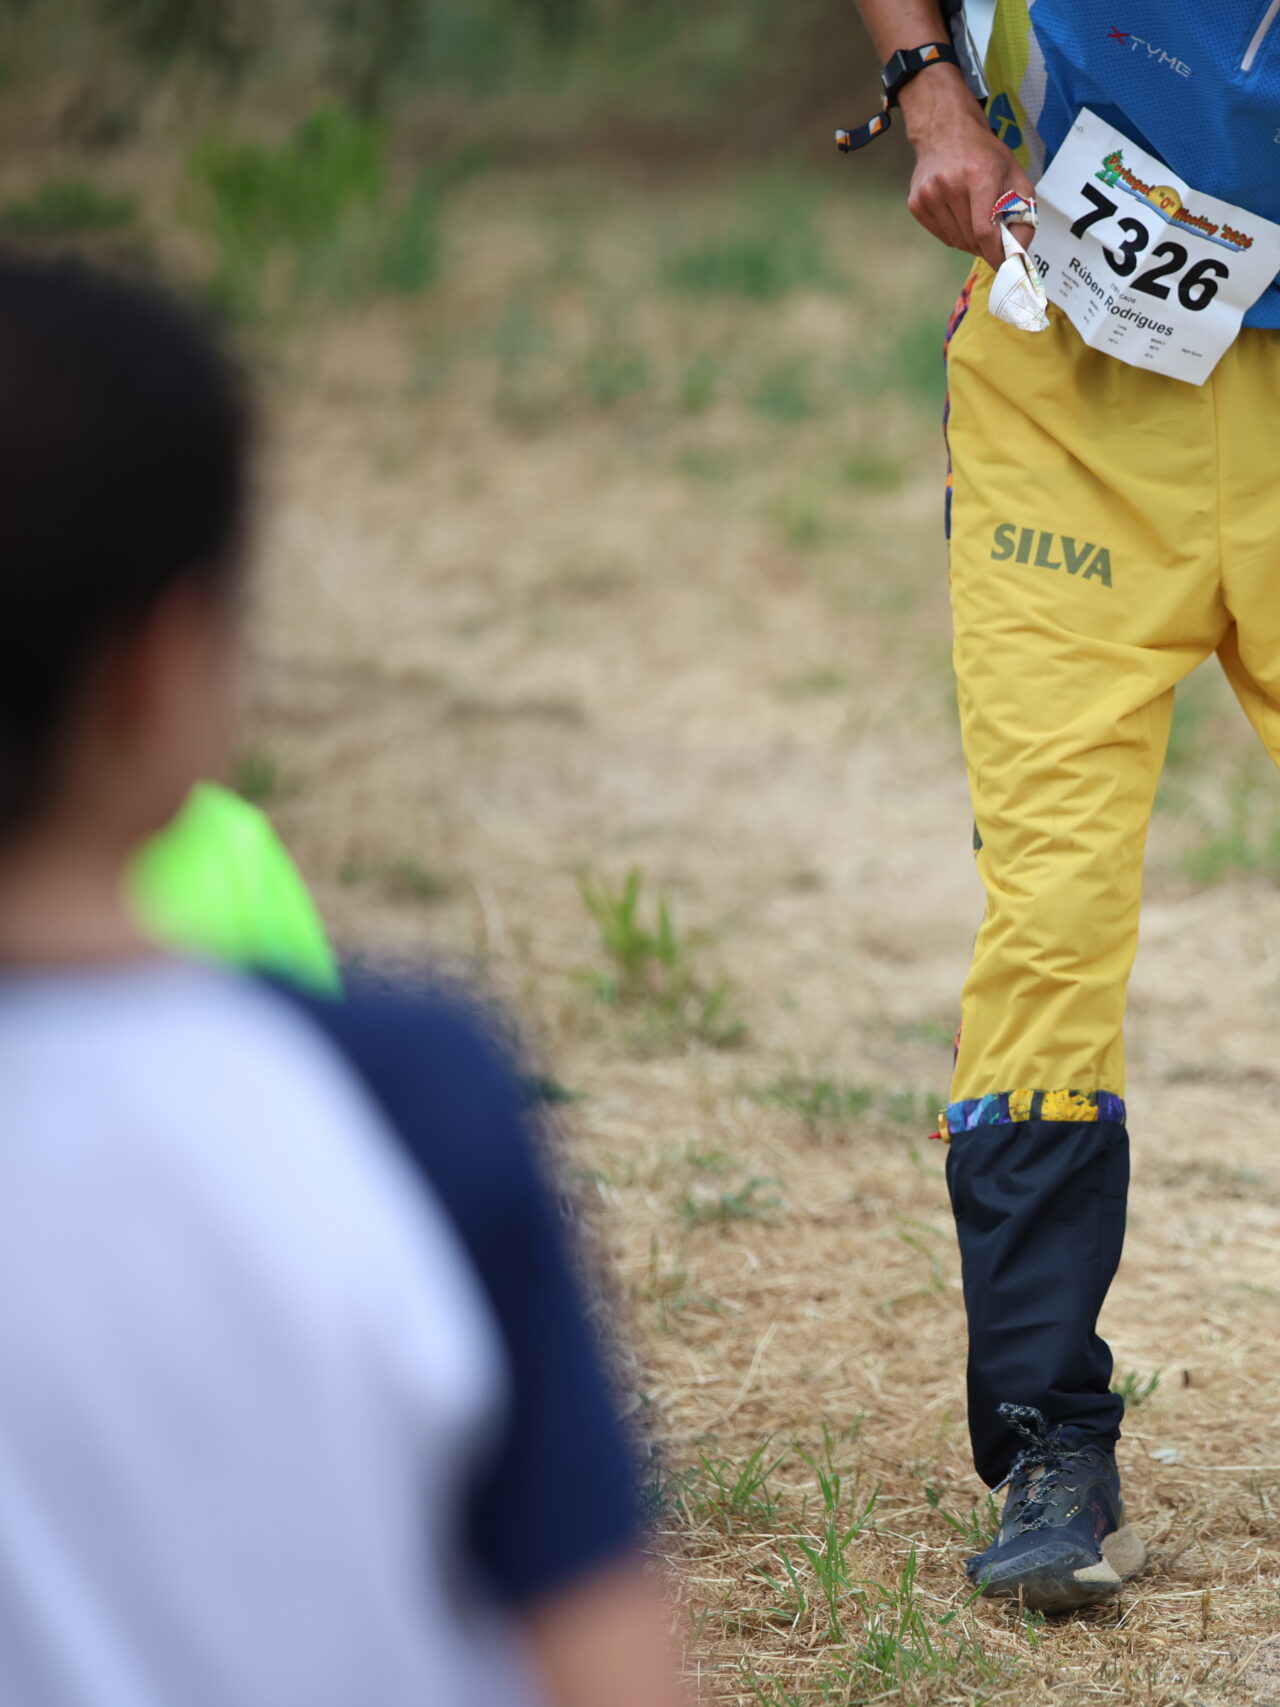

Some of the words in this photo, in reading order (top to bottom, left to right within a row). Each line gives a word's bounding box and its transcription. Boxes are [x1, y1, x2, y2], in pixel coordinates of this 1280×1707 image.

[1108, 155, 1156, 197] Portugal
[1173, 207, 1219, 236] Meeting
[1070, 182, 1229, 311] 7326
[1068, 257, 1105, 300] Rúben
[1104, 296, 1174, 337] Rodrigues
[990, 522, 1113, 589] SILVA
